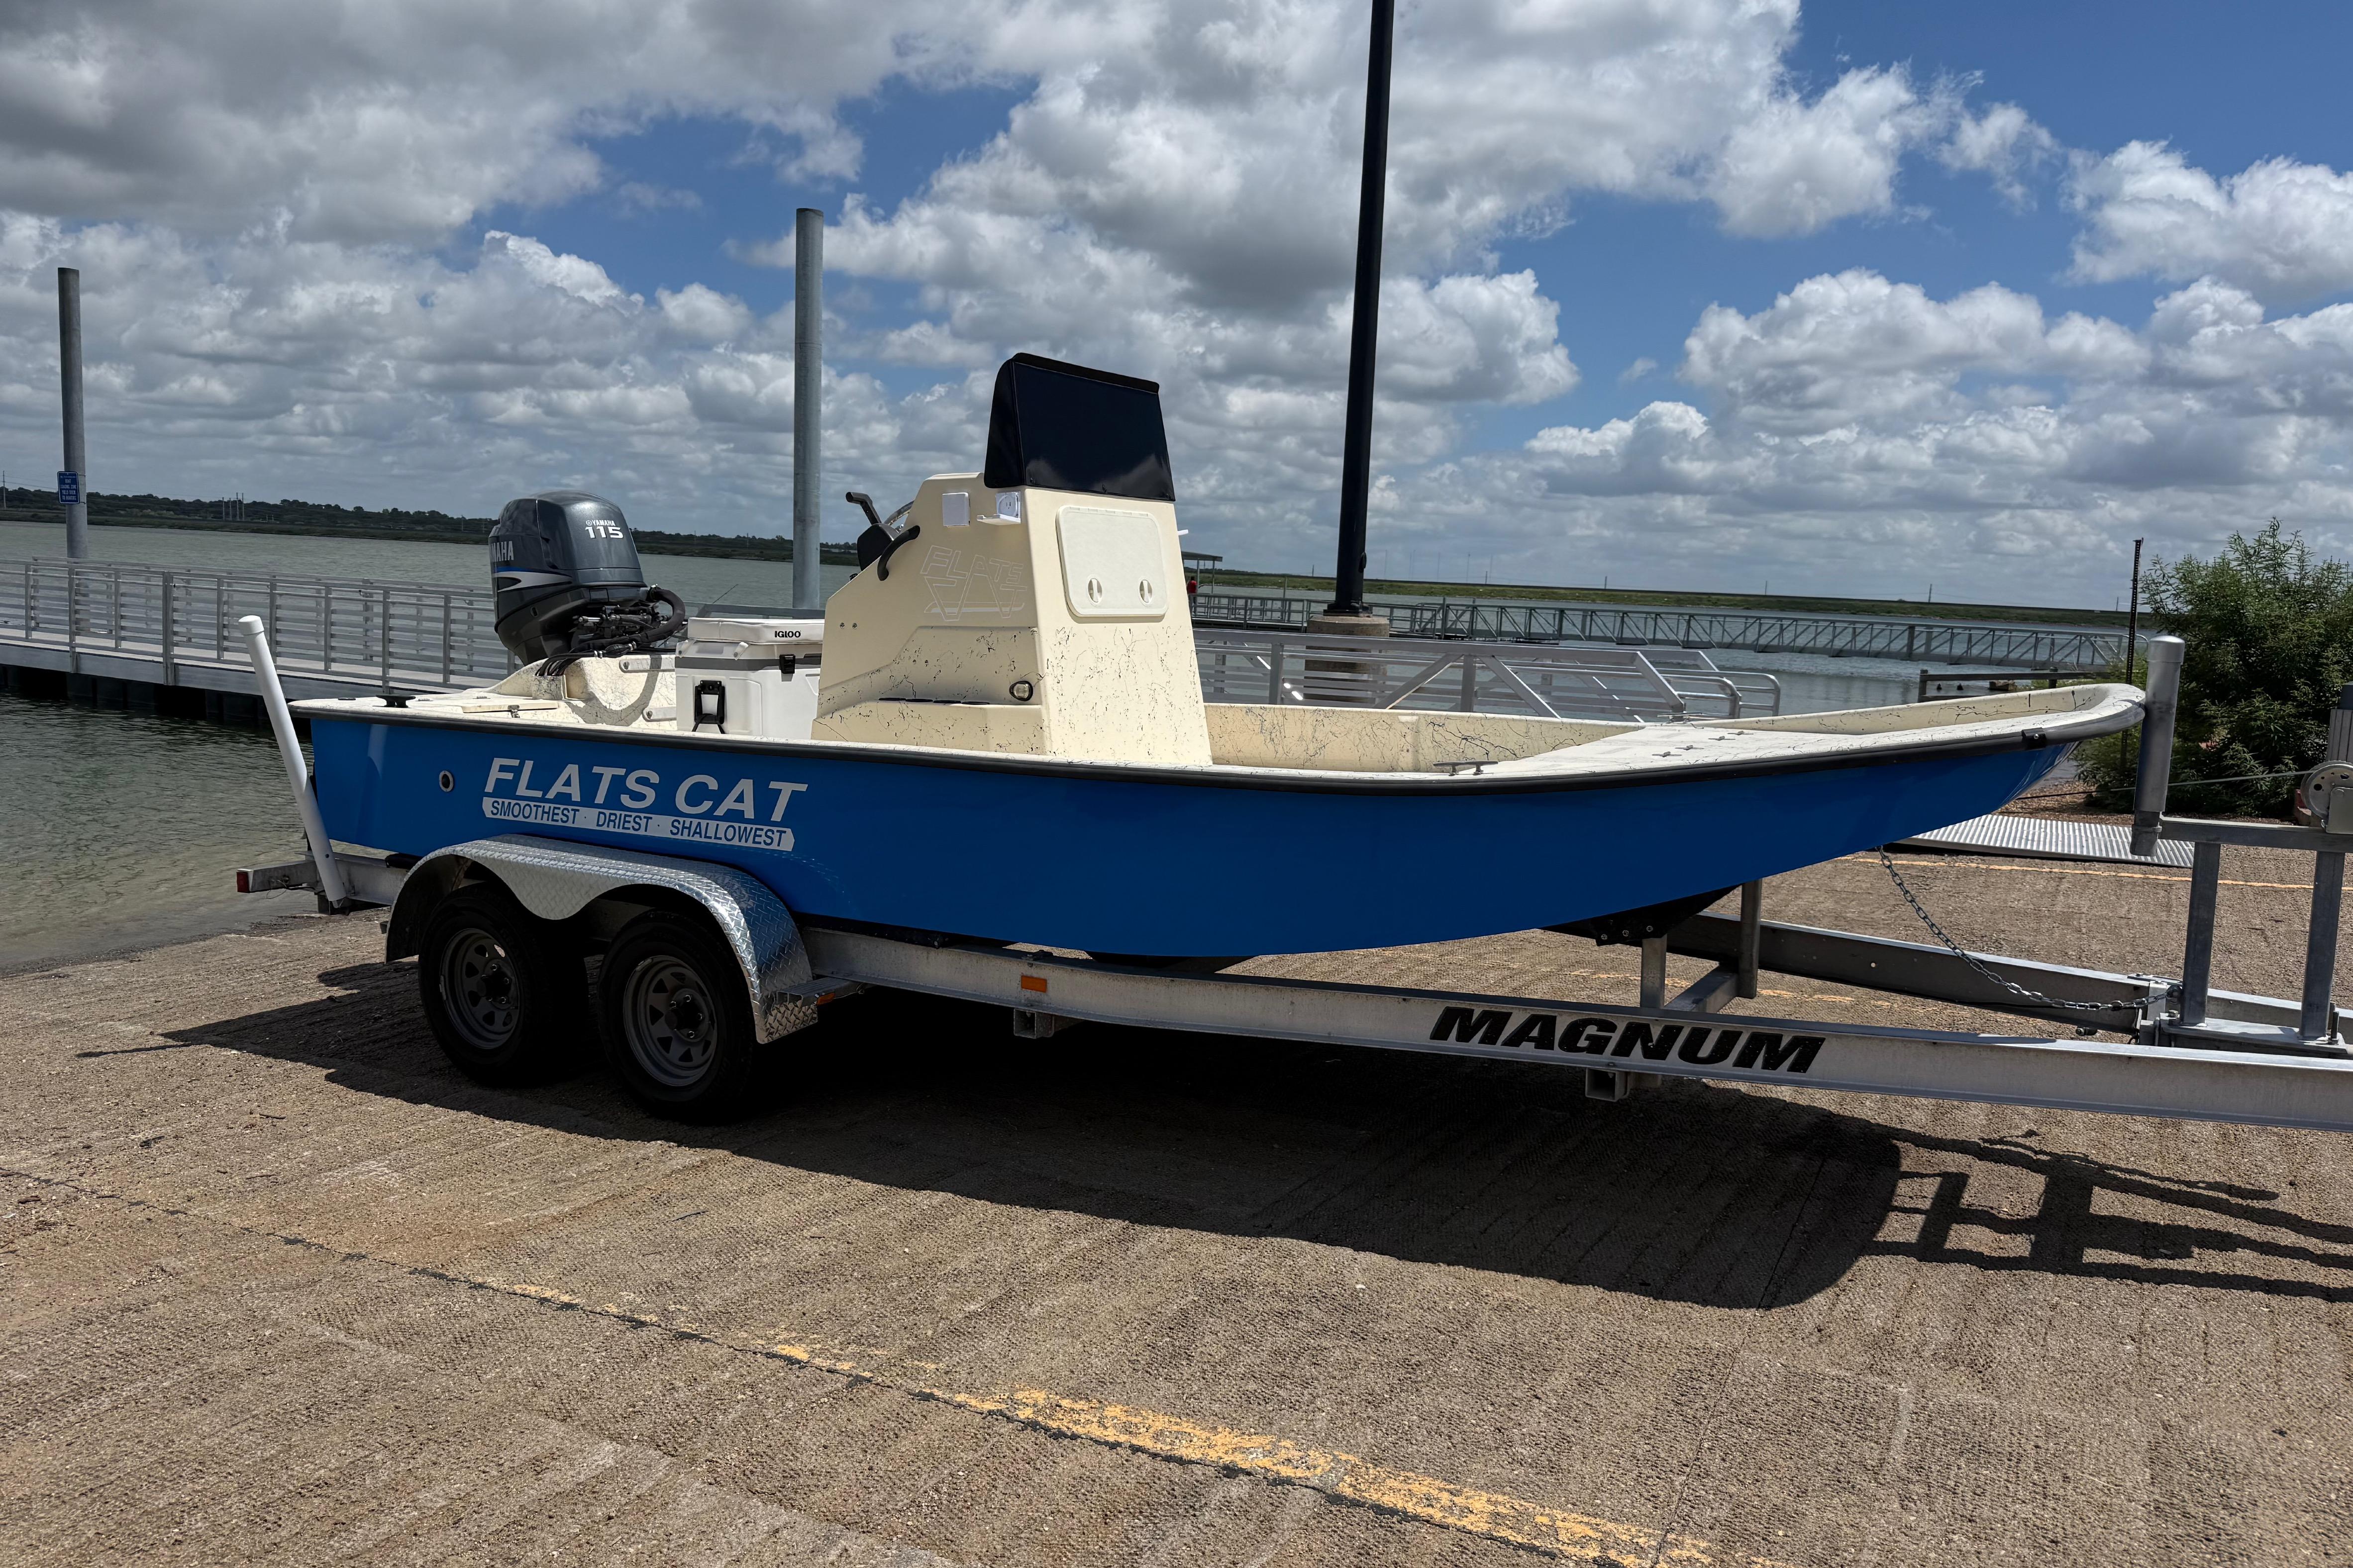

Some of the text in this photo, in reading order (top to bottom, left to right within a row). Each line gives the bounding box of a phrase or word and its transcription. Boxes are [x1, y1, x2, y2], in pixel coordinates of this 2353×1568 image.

[585, 526, 623, 539] 115
[485, 758, 808, 821] FLATS CAT
[491, 800, 787, 847] SMOOTHEST DRIEST SHALLOWEST
[1430, 1006, 1826, 1074] MAGNUM
